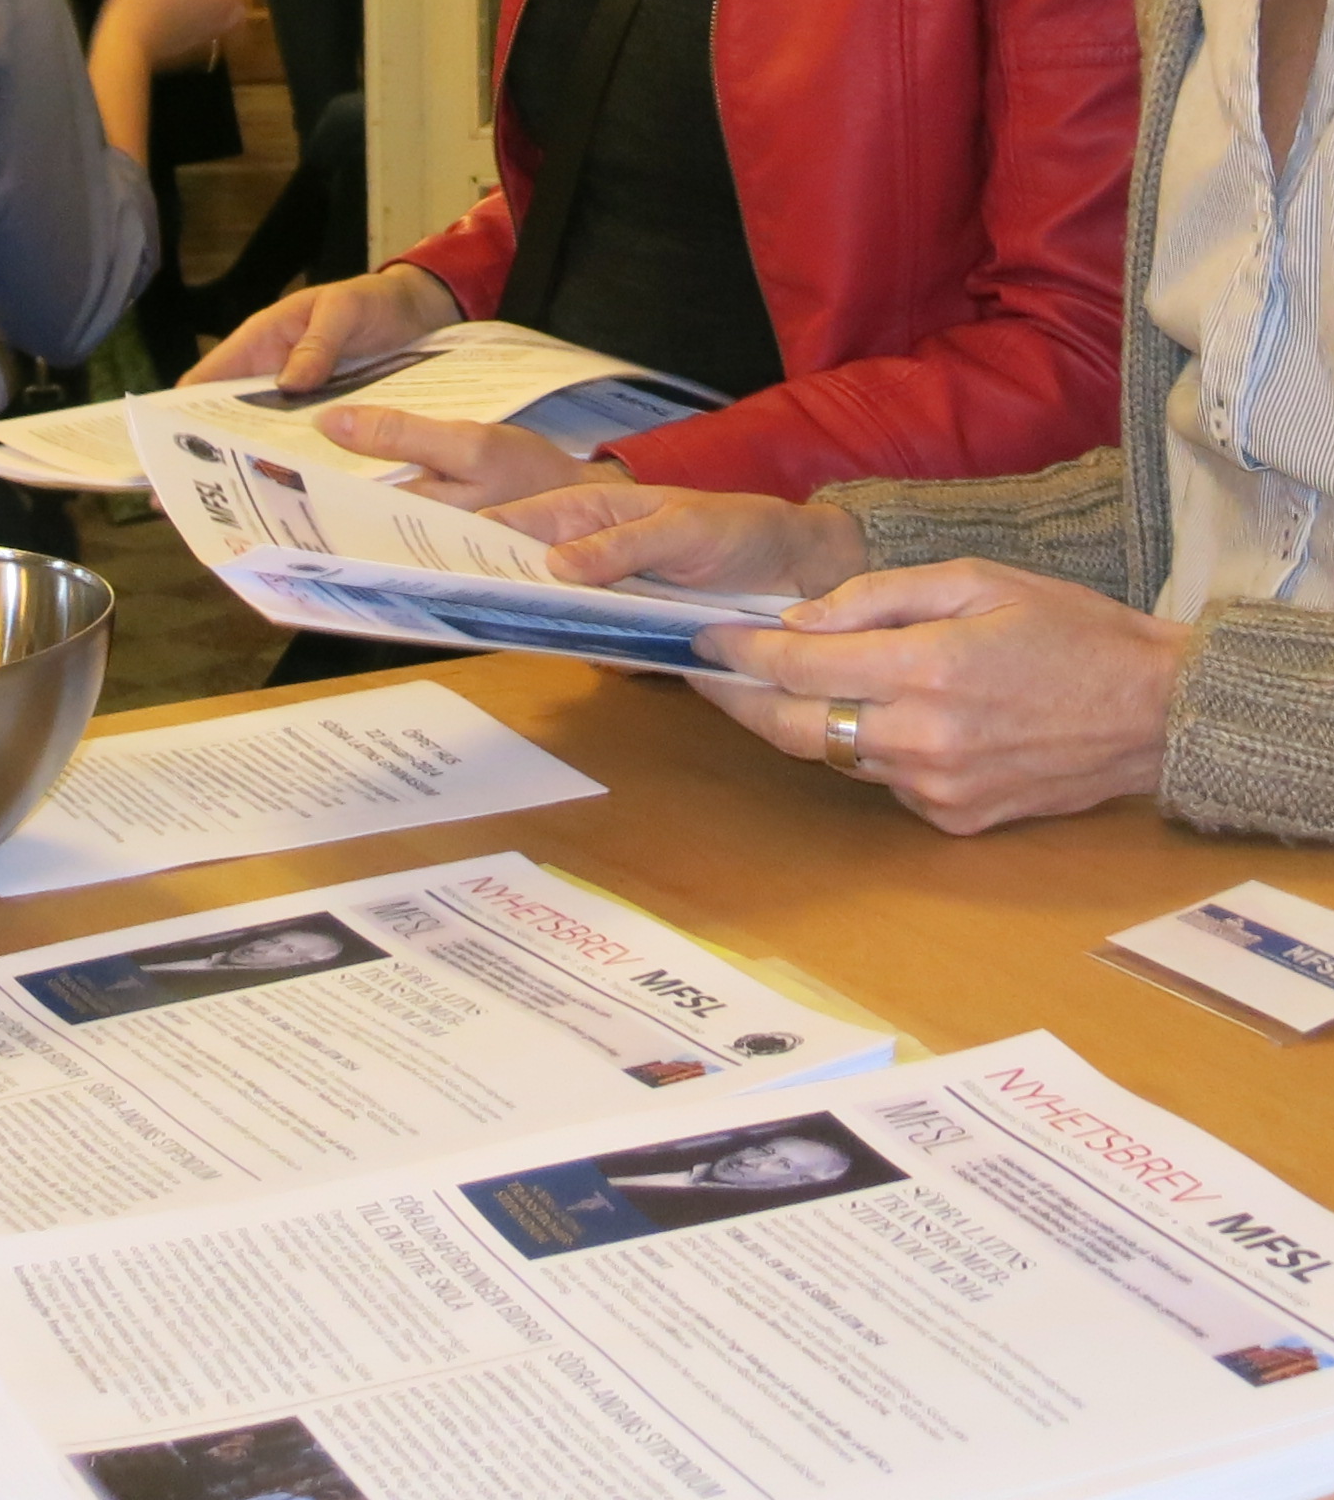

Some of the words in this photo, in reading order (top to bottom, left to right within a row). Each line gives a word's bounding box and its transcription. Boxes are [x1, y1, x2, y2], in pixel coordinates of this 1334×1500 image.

[367, 899, 447, 942] MFSL
[457, 875, 645, 967] NYHETSBREV
[630, 968, 729, 1019] MFSL
[874, 1099, 976, 1156] MFSL
[984, 1066, 1223, 1204] NYHETSBREV
[1208, 1211, 1334, 1286] MFSL
[356, 1201, 390, 1227] TILL
[374, 1224, 407, 1242] EN
[902, 1186, 971, 1228] SÖDRA
[960, 1225, 1037, 1272] LATINS
[388, 1239, 443, 1279] BÄTTRE
[838, 1201, 955, 1275] STIPENDIUM
[939, 1272, 995, 1302] 2014
[425, 1275, 474, 1312] SKOLA
